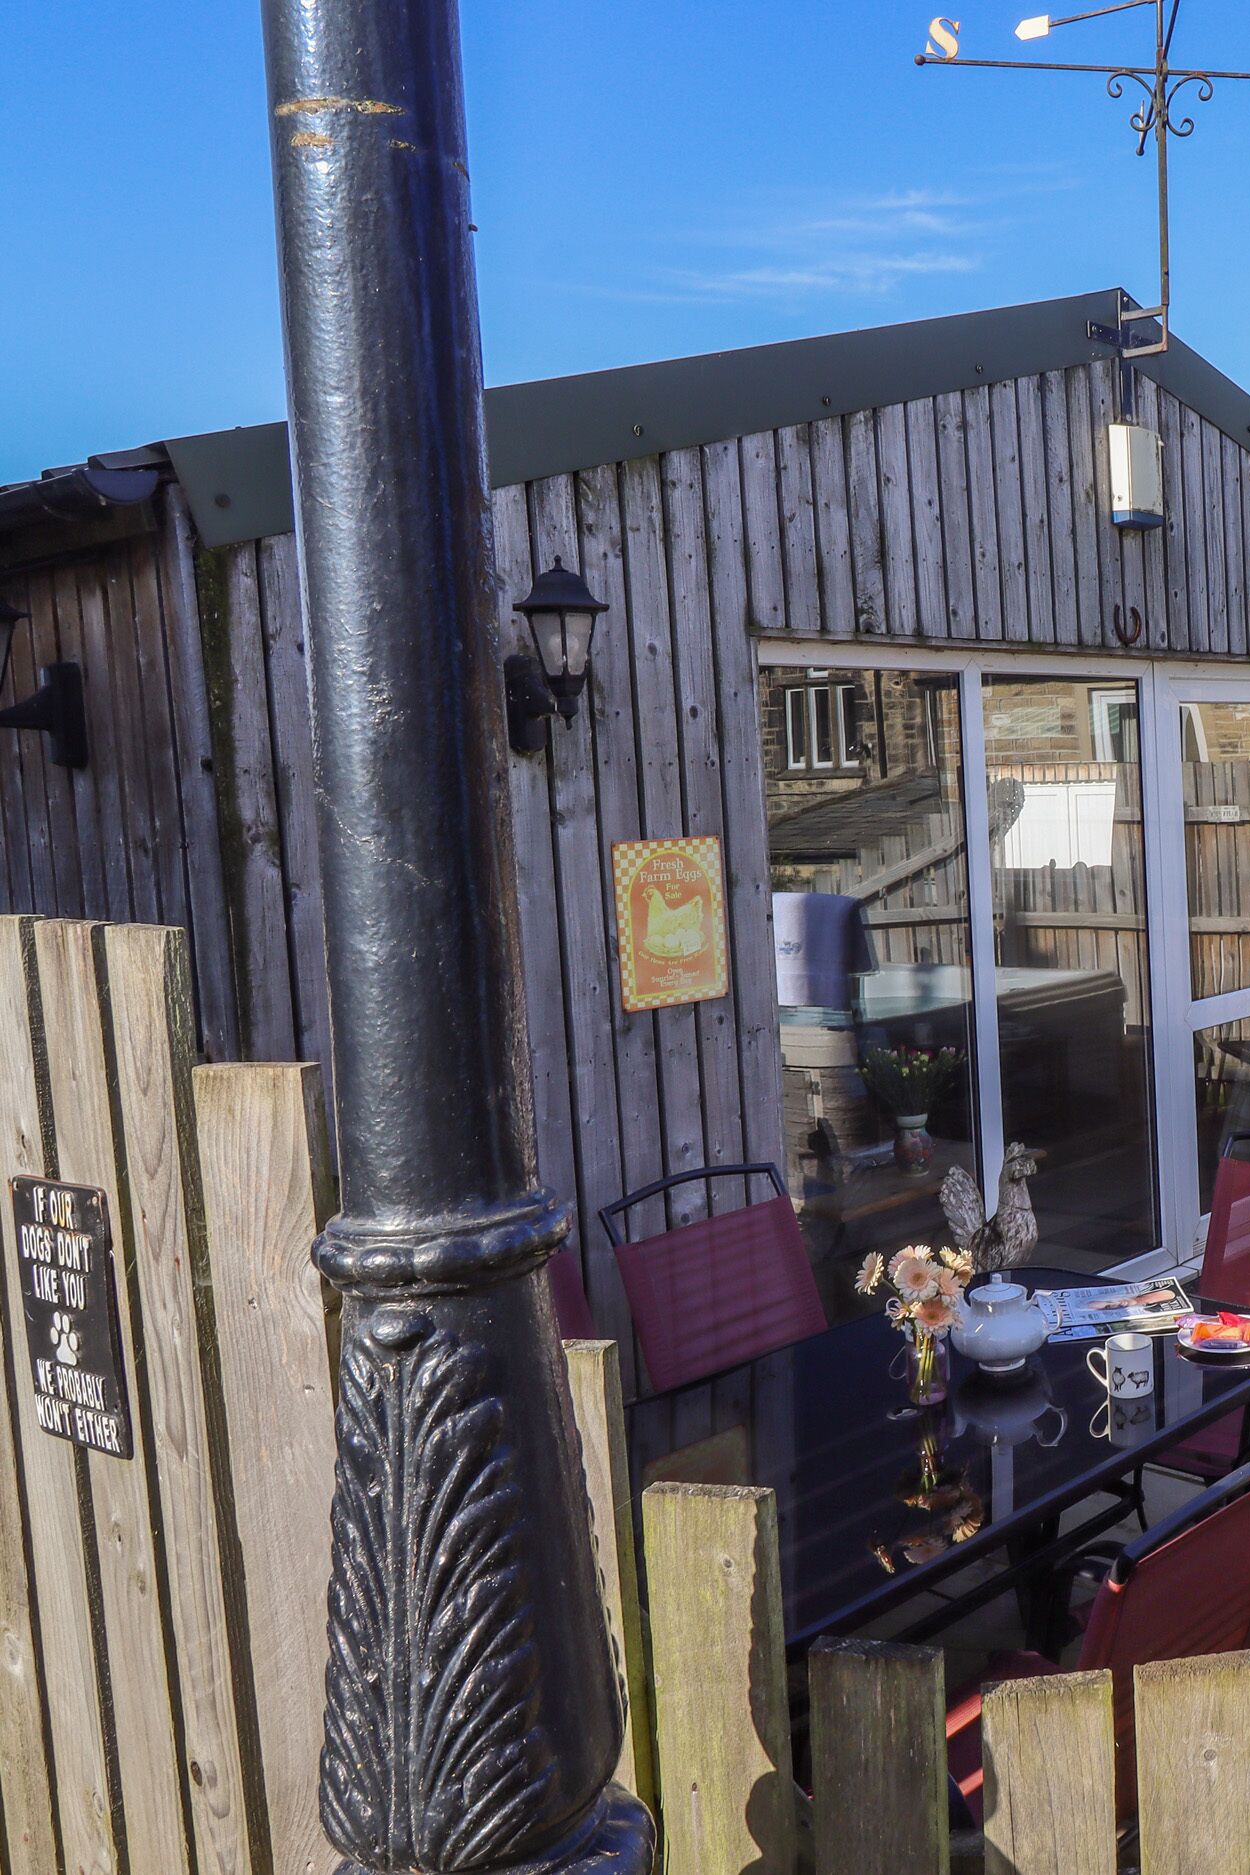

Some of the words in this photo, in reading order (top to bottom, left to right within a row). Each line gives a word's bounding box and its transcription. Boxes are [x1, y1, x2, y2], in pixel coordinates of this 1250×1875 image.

[925, 17, 960, 60] S
[640, 871, 671, 883] Farm
[676, 869, 702, 882] Eggs
[653, 858, 684, 871] Fresh
[664, 891, 682, 900] Sale
[665, 883, 680, 891] For
[33, 1187, 46, 1222] IF
[50, 1188, 74, 1229] OUR
[22, 1225, 52, 1264] DOGS
[58, 1231, 90, 1272] DON'T
[33, 1264, 58, 1304] LIKE
[62, 1272, 85, 1310] YOU
[37, 1358, 54, 1395] WE
[56, 1365, 106, 1411] PROBABLY
[35, 1393, 71, 1436] WON'T
[75, 1407, 121, 1453] EITHER
